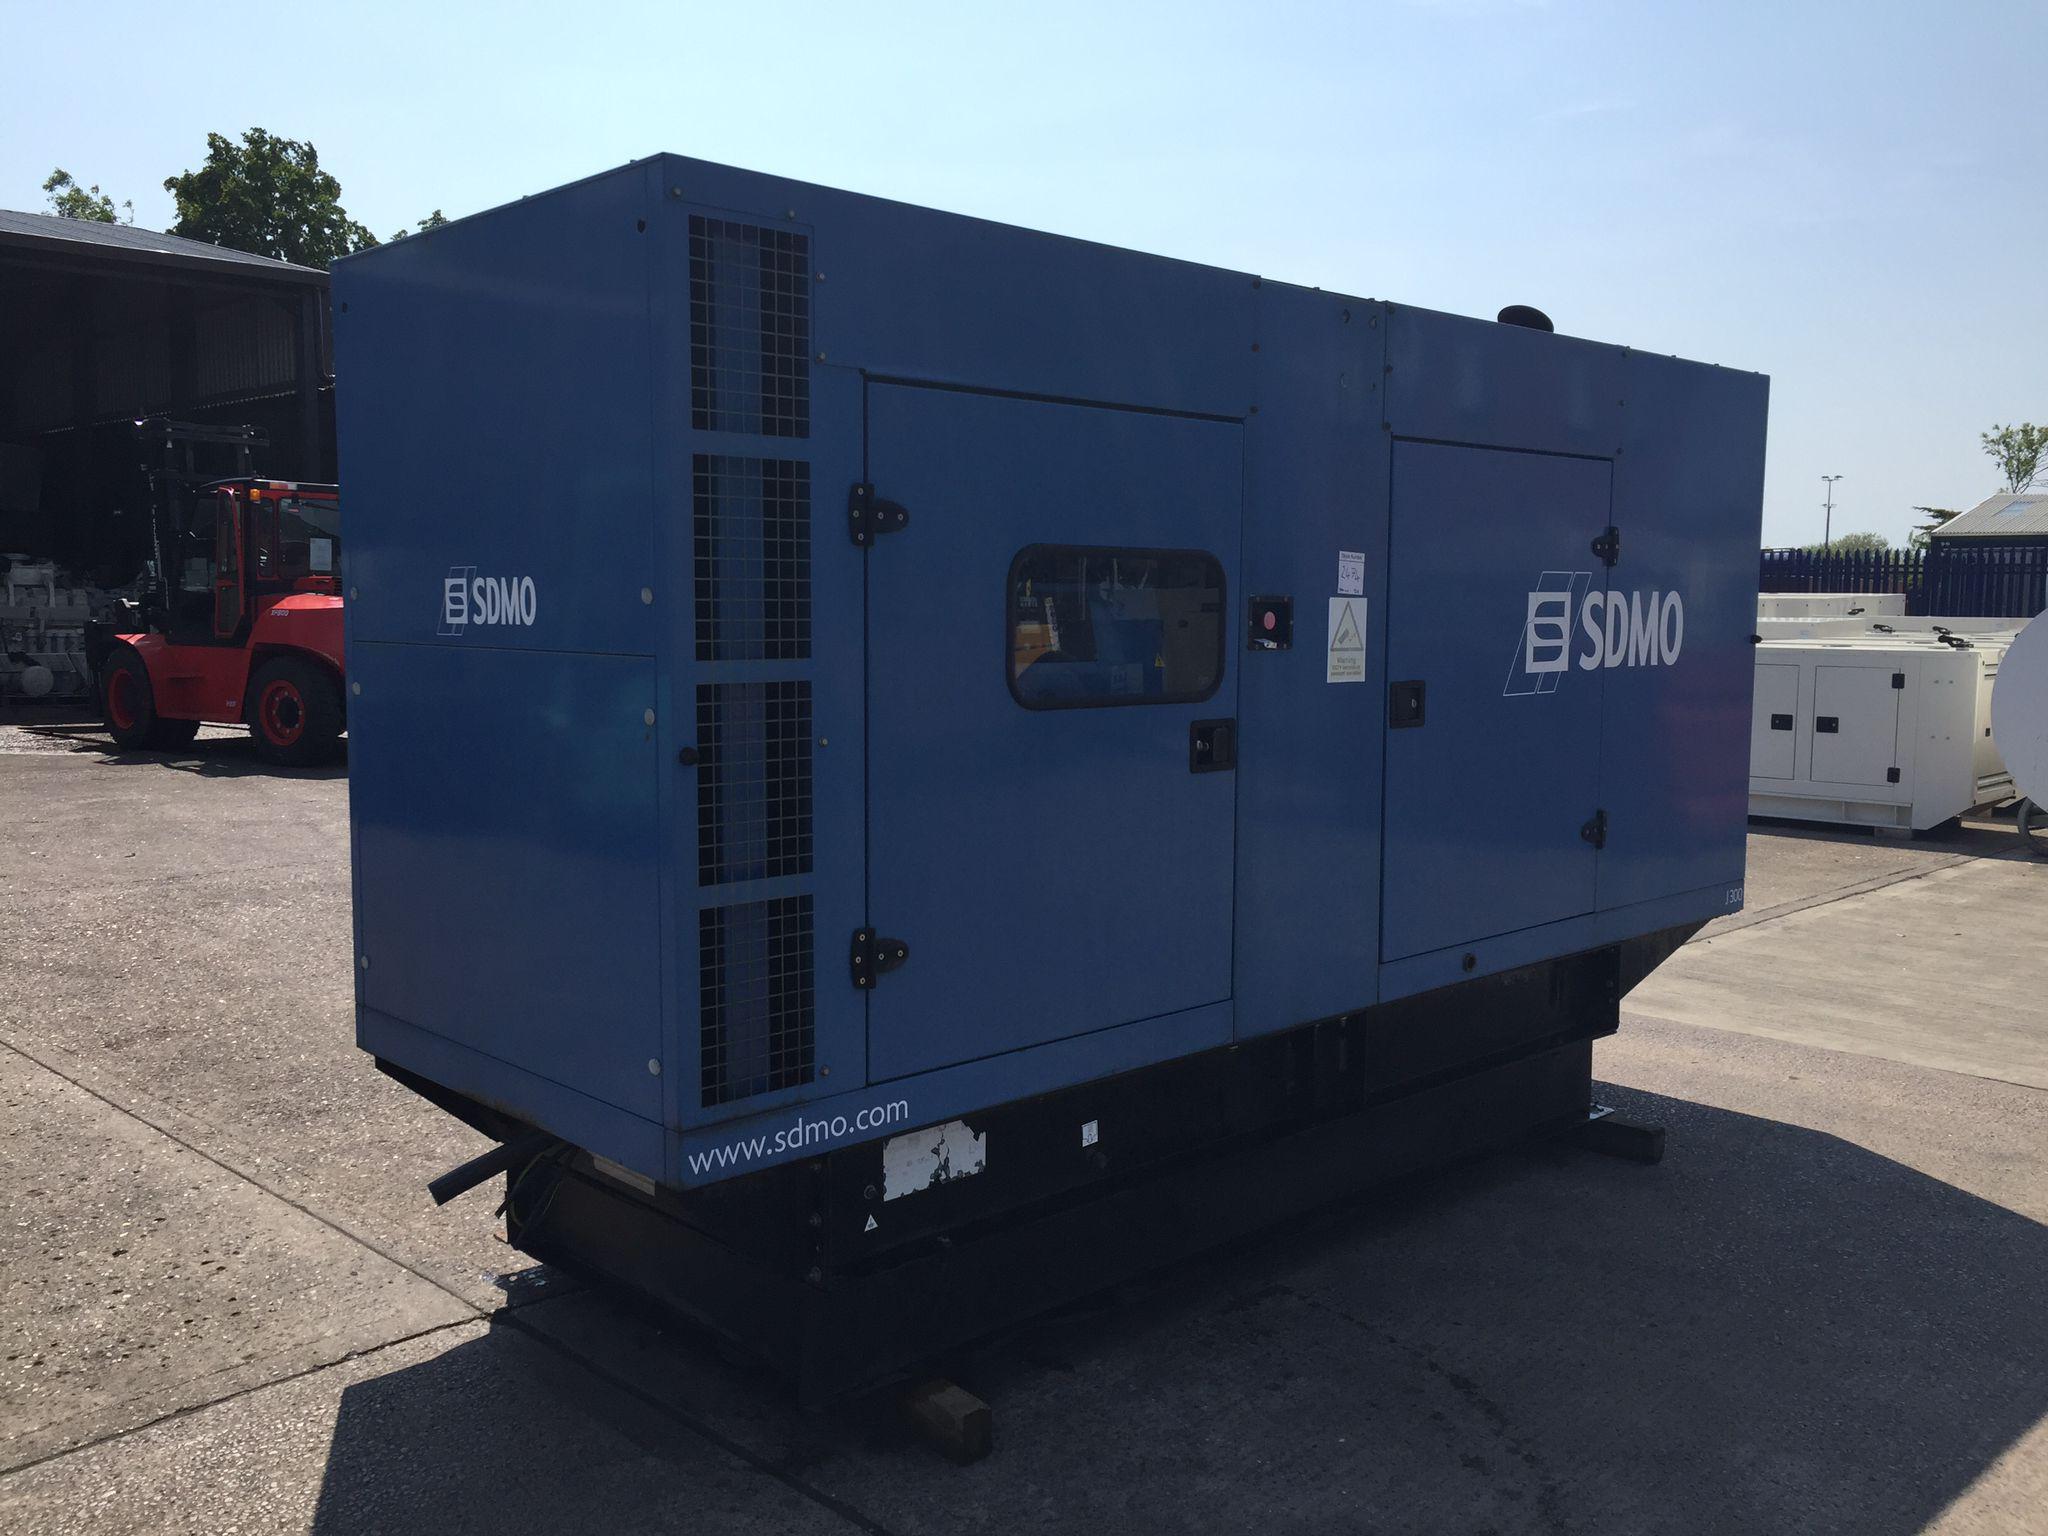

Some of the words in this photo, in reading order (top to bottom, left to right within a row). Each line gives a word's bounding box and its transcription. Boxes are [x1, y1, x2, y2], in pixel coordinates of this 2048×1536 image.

[473, 576, 536, 626] SDMO
[1579, 590, 1684, 671] SDMO
[688, 1100, 908, 1175] www.sdmo.com
